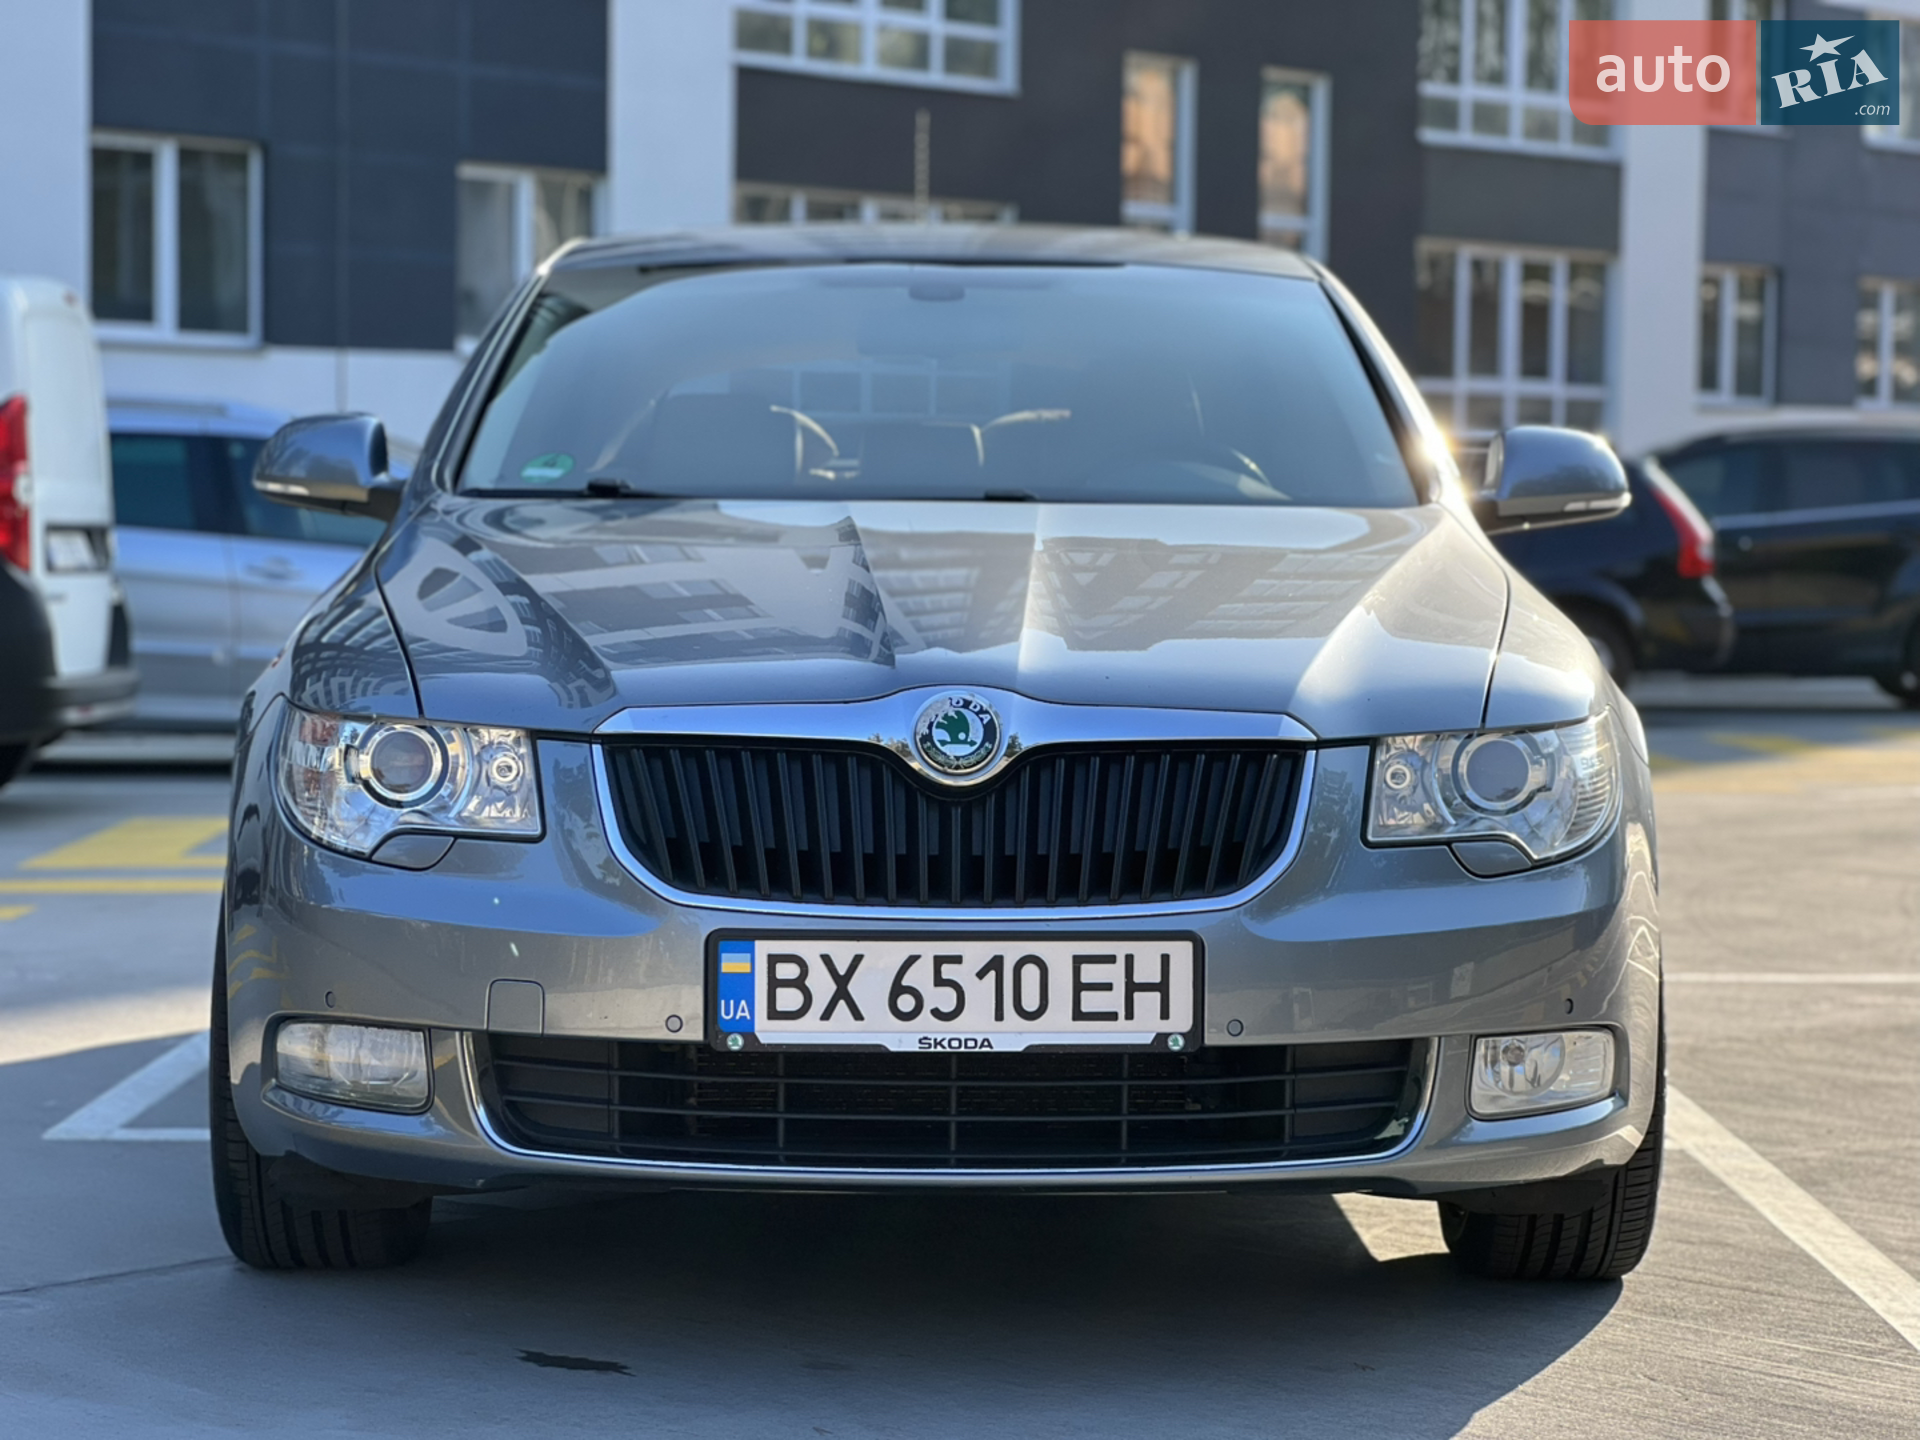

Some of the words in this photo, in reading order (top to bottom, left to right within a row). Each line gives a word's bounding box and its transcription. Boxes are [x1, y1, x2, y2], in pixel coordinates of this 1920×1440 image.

[767, 954, 865, 1021] BX
[888, 954, 1049, 1022] 6510
[1072, 954, 1171, 1021] EH
[721, 1000, 751, 1020] UA
[917, 1035, 995, 1051] ŠKODA
